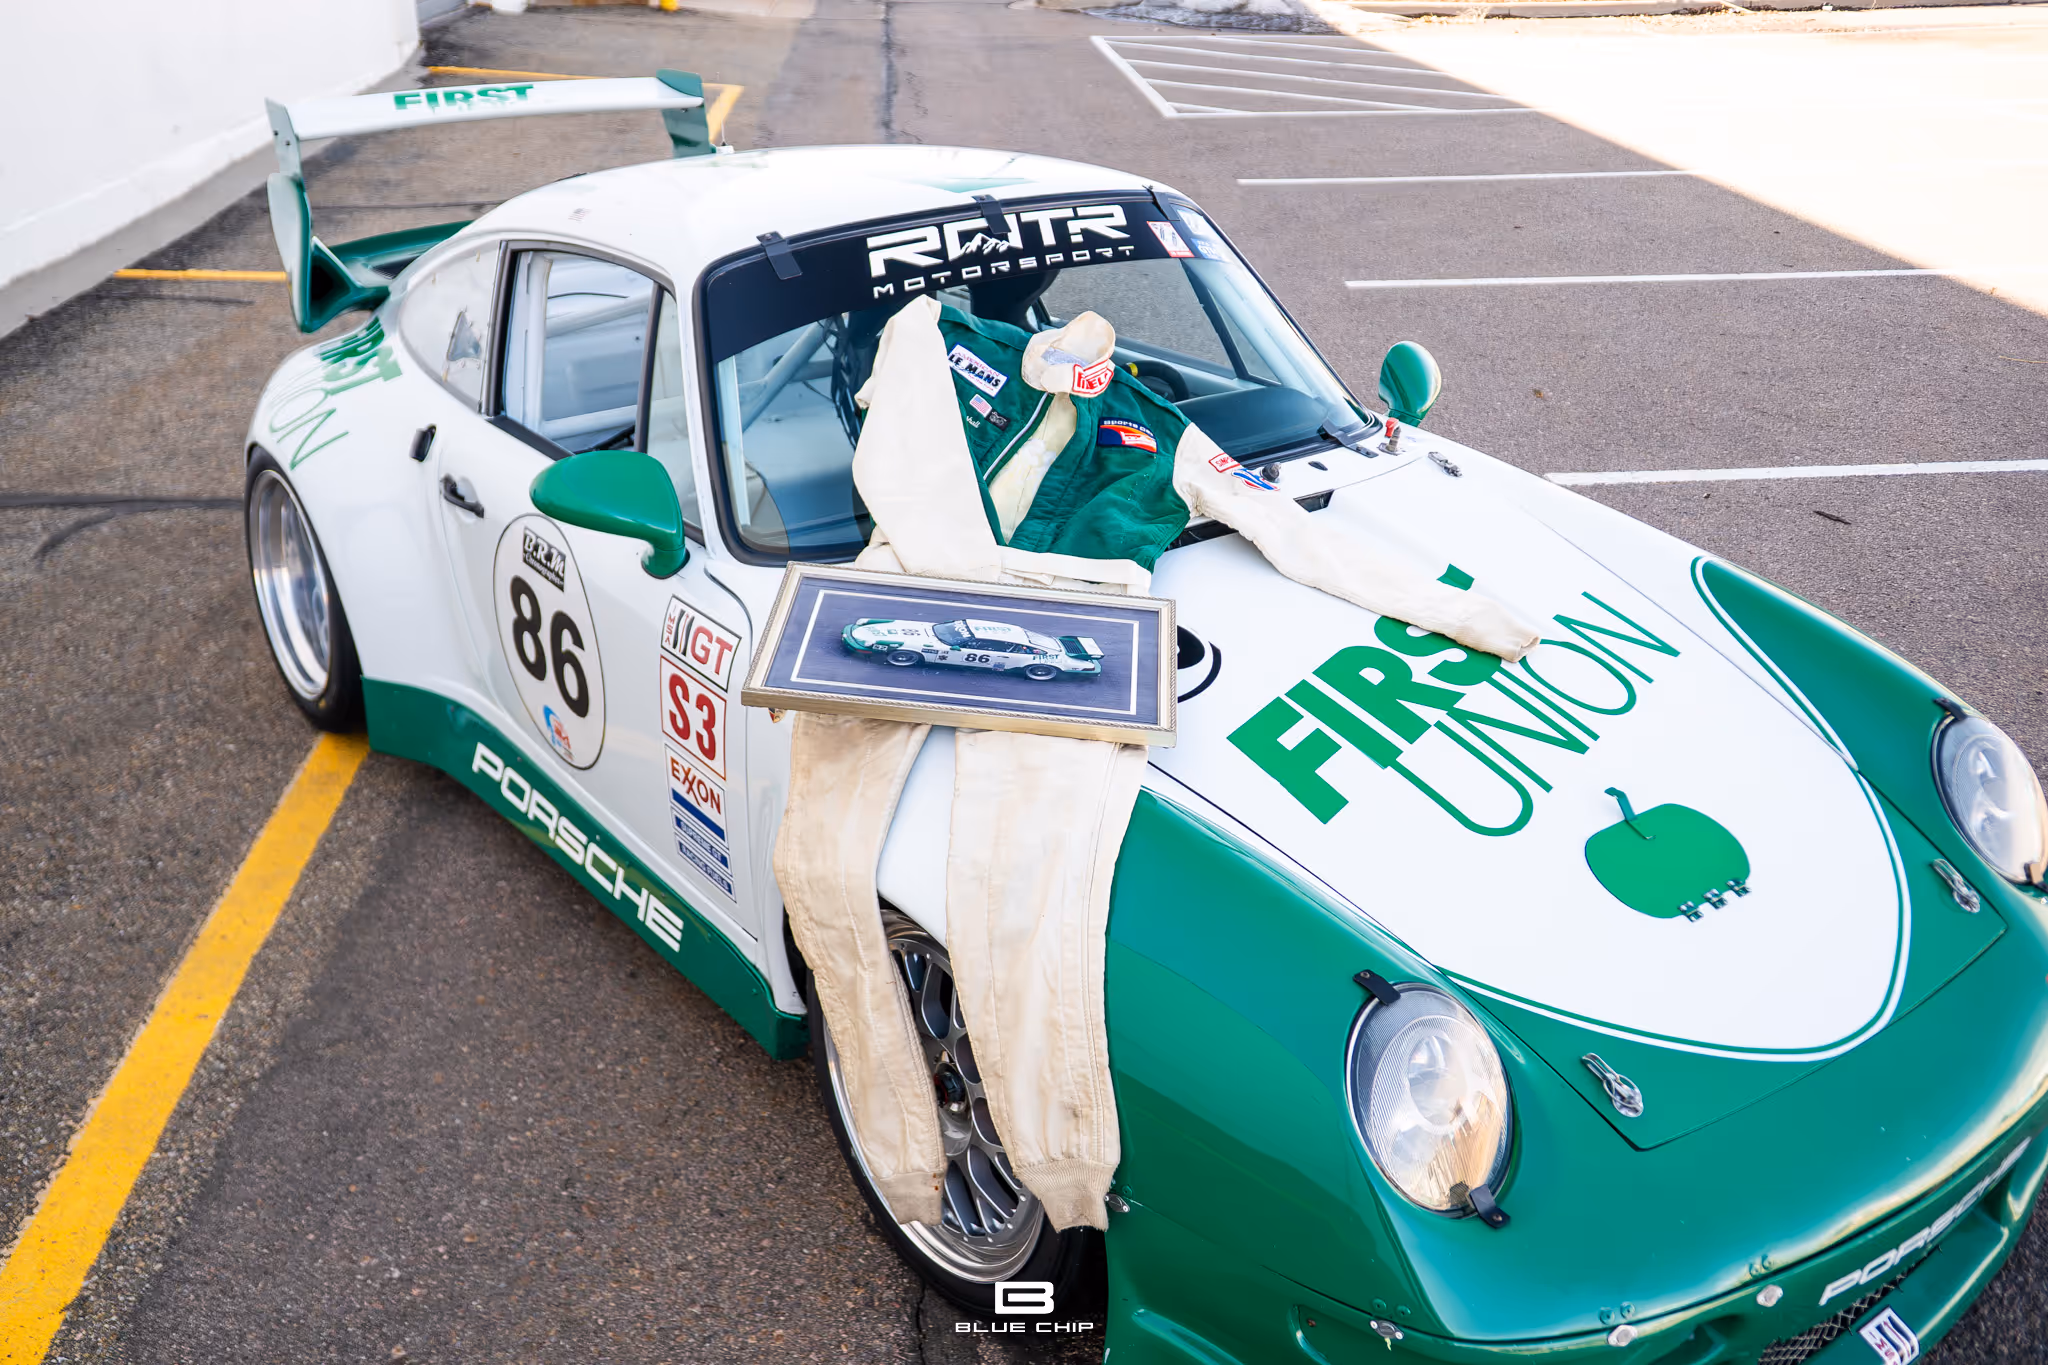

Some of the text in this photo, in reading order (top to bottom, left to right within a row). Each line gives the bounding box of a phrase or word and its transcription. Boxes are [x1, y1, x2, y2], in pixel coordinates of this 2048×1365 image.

[394, 84, 534, 110] FIRST
[866, 204, 1130, 278] ROTR
[873, 246, 1134, 298] MOTORSPORT
[948, 354, 963, 366] LE
[964, 363, 1001, 388] MANS
[510, 575, 589, 718] 86
[690, 625, 733, 676] GT
[964, 653, 990, 663] 86
[1033, 653, 1060, 661] FIRST
[669, 672, 716, 761] S3
[1226, 562, 1504, 824] FIRS
[1388, 591, 1681, 836] UNION
[670, 756, 721, 816] EXXON
[472, 742, 684, 953] PORSCHE
